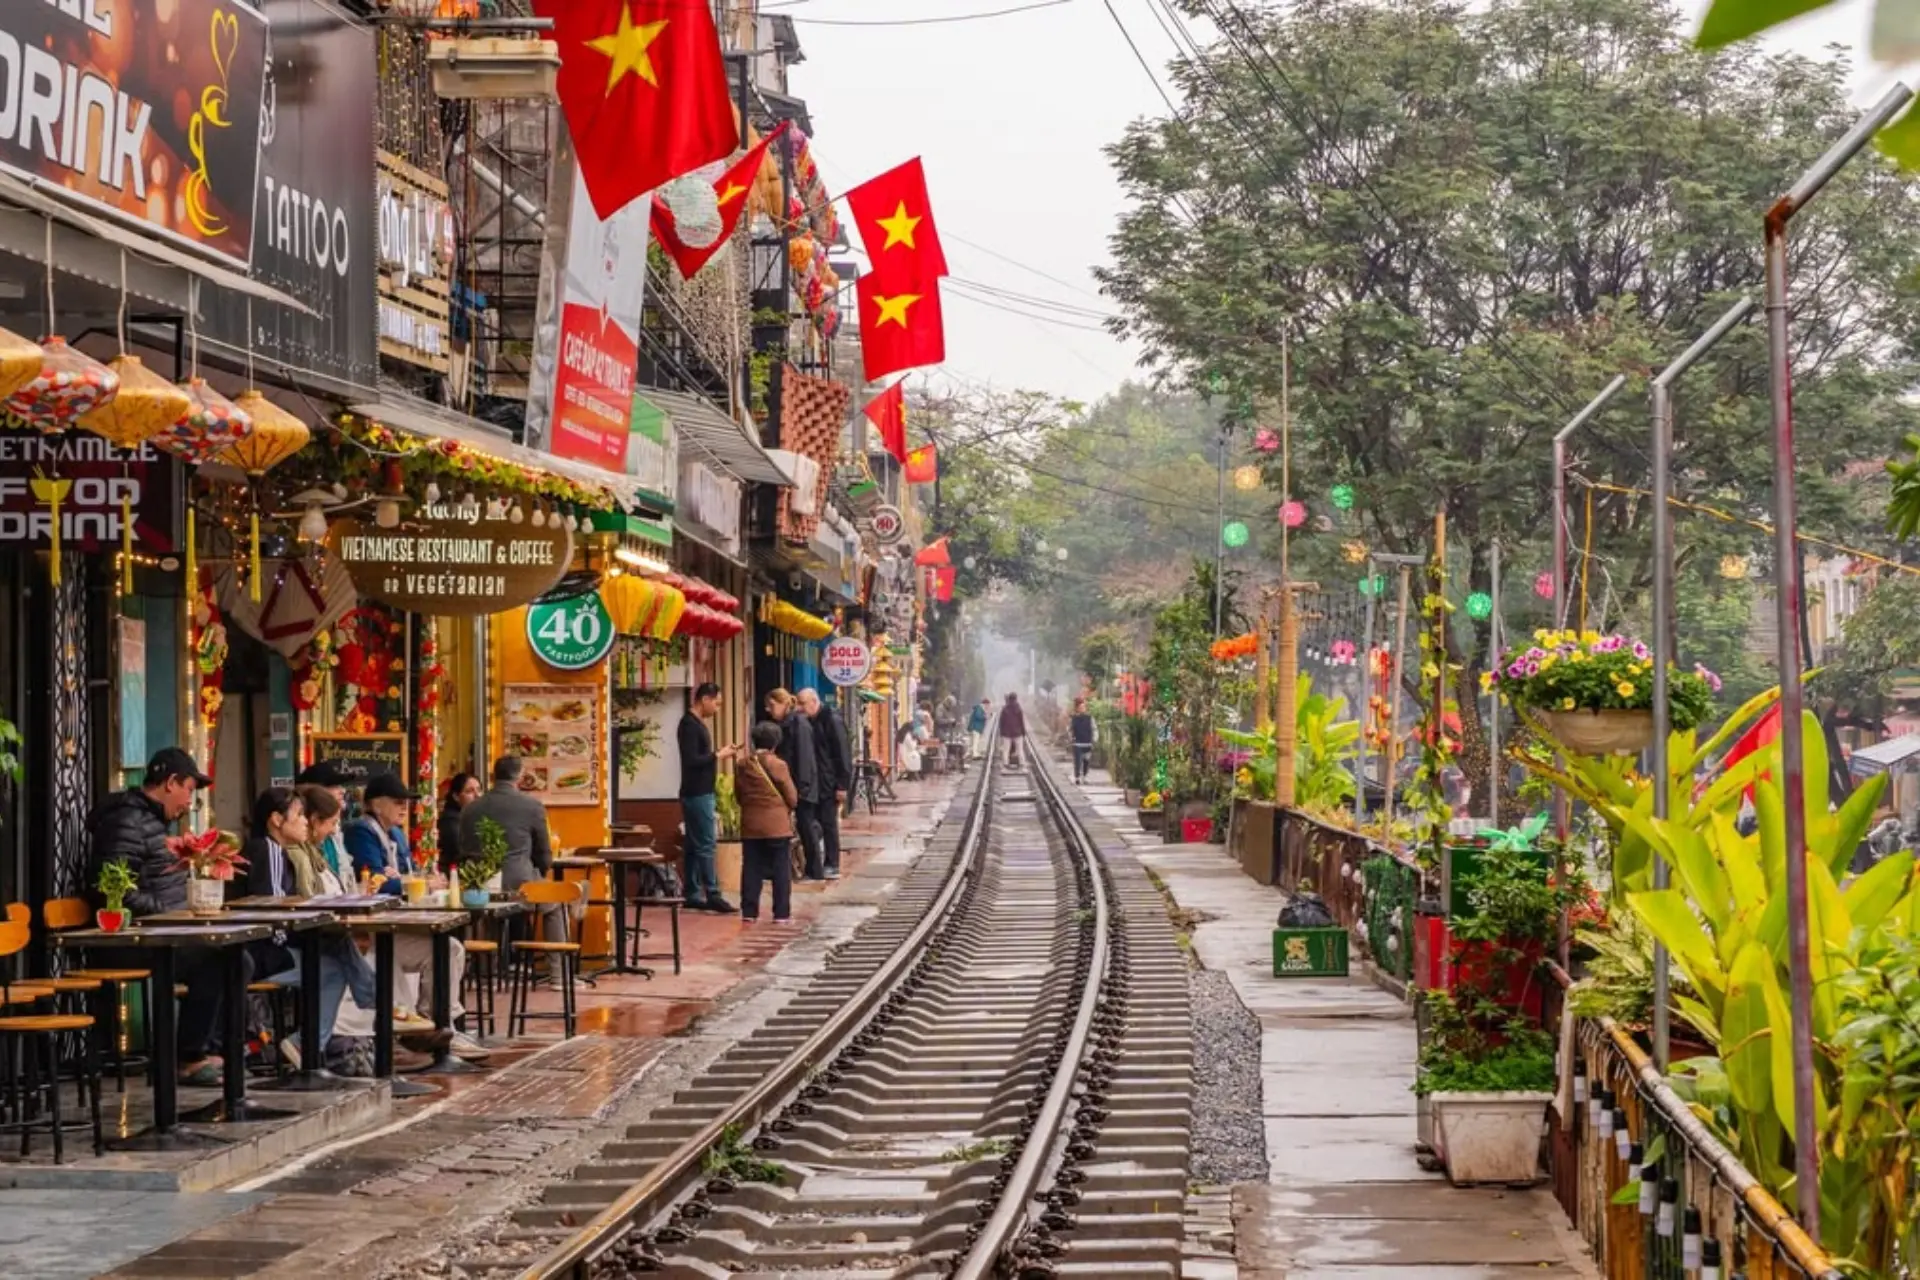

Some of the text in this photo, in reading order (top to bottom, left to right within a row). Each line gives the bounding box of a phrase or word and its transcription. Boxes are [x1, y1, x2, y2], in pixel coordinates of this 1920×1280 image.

[265, 175, 349, 277] TATTOO
[0, 436, 158, 462] ETNAMEE
[0, 477, 141, 505] FOD
[341, 535, 554, 565] VIETNAMESE RESTAURANT & COFFEE
[544, 644, 596, 662] FASTFOOD
